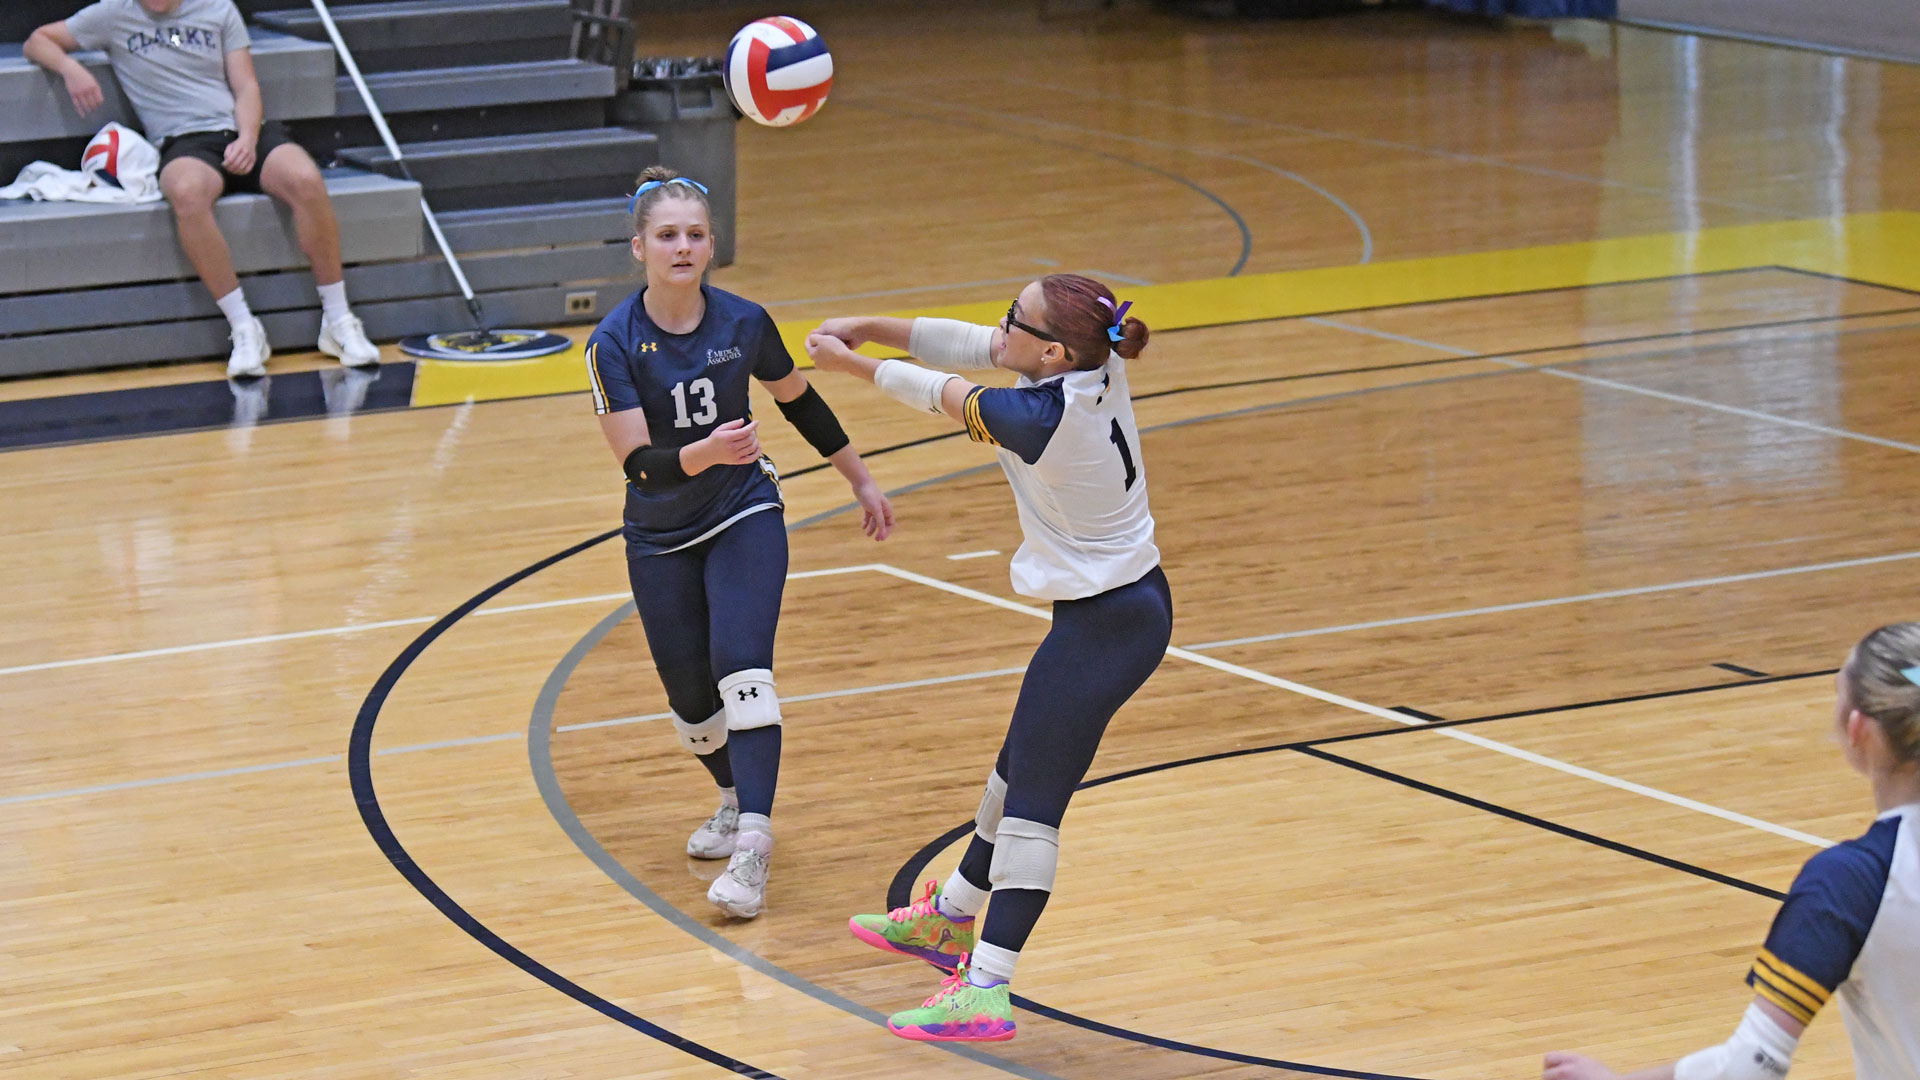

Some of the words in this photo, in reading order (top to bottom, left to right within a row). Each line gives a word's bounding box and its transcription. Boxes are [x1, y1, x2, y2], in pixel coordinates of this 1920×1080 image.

[127, 27, 216, 54] CLARKE
[670, 377, 718, 428] 13
[1109, 416, 1137, 493] 1
